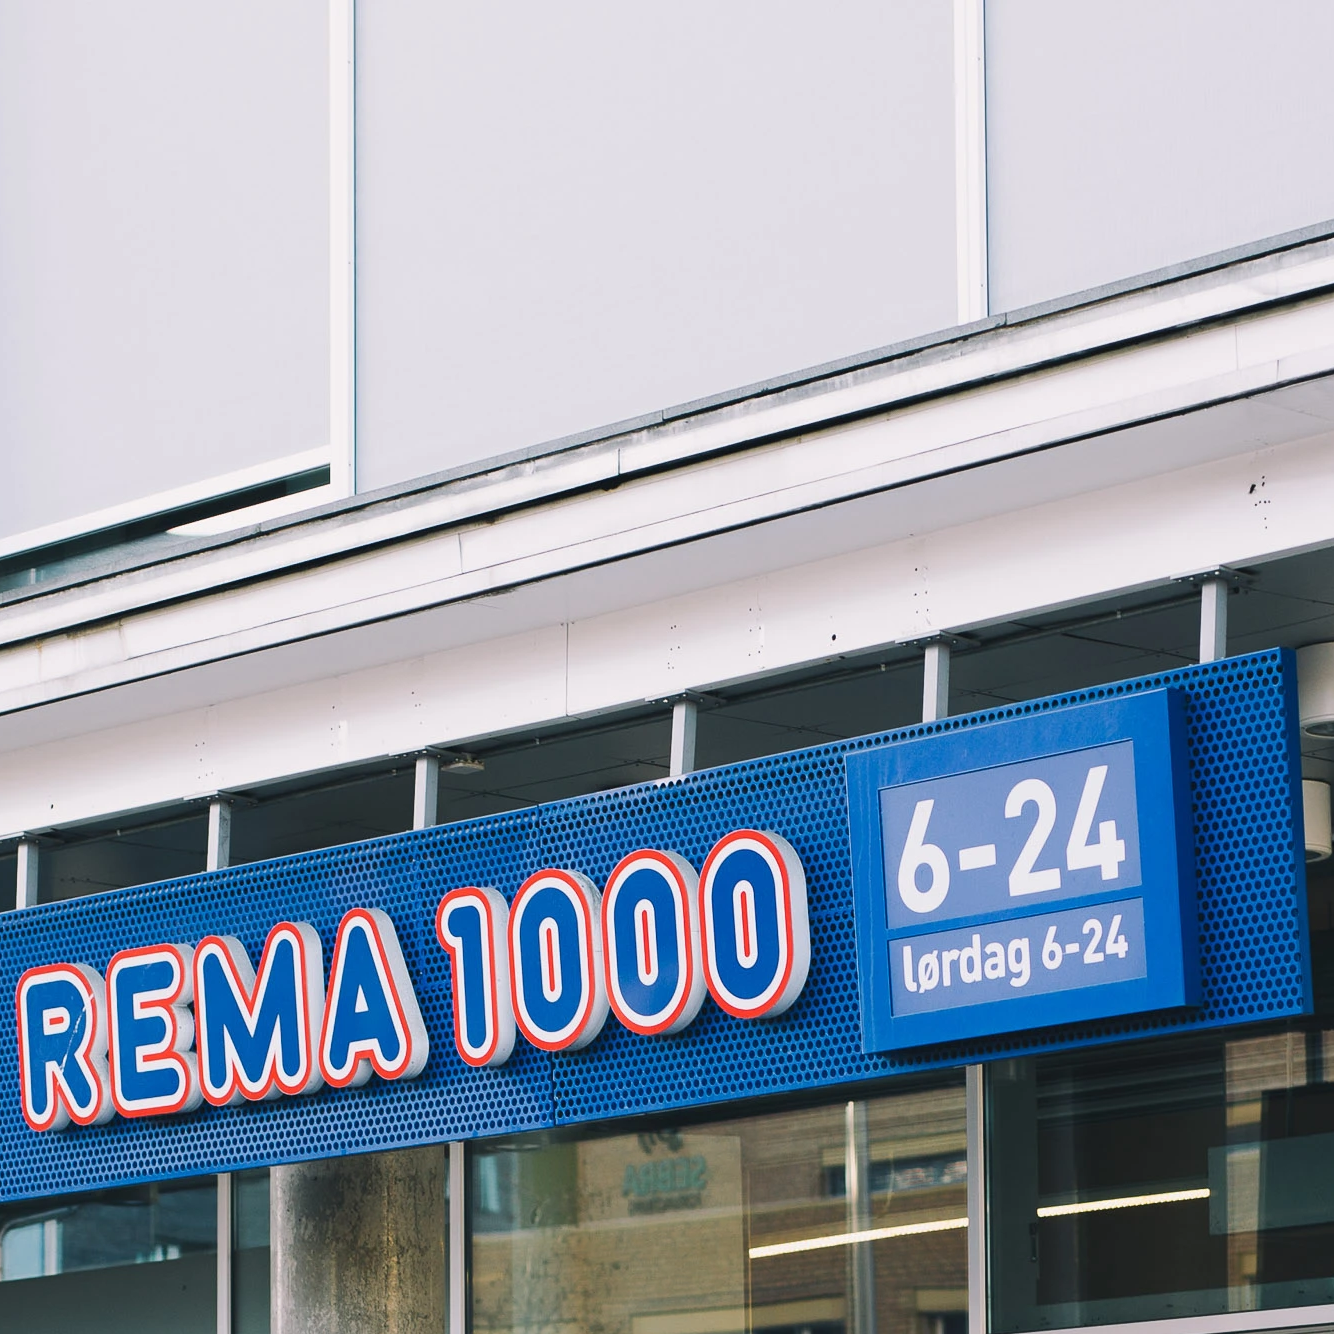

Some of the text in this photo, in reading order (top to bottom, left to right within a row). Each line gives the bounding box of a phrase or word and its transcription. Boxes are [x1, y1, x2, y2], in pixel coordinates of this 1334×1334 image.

[896, 764, 1127, 914] 6-24
[16, 829, 808, 1132] REMA 1000
[903, 917, 1129, 995] lørdag 6-24
